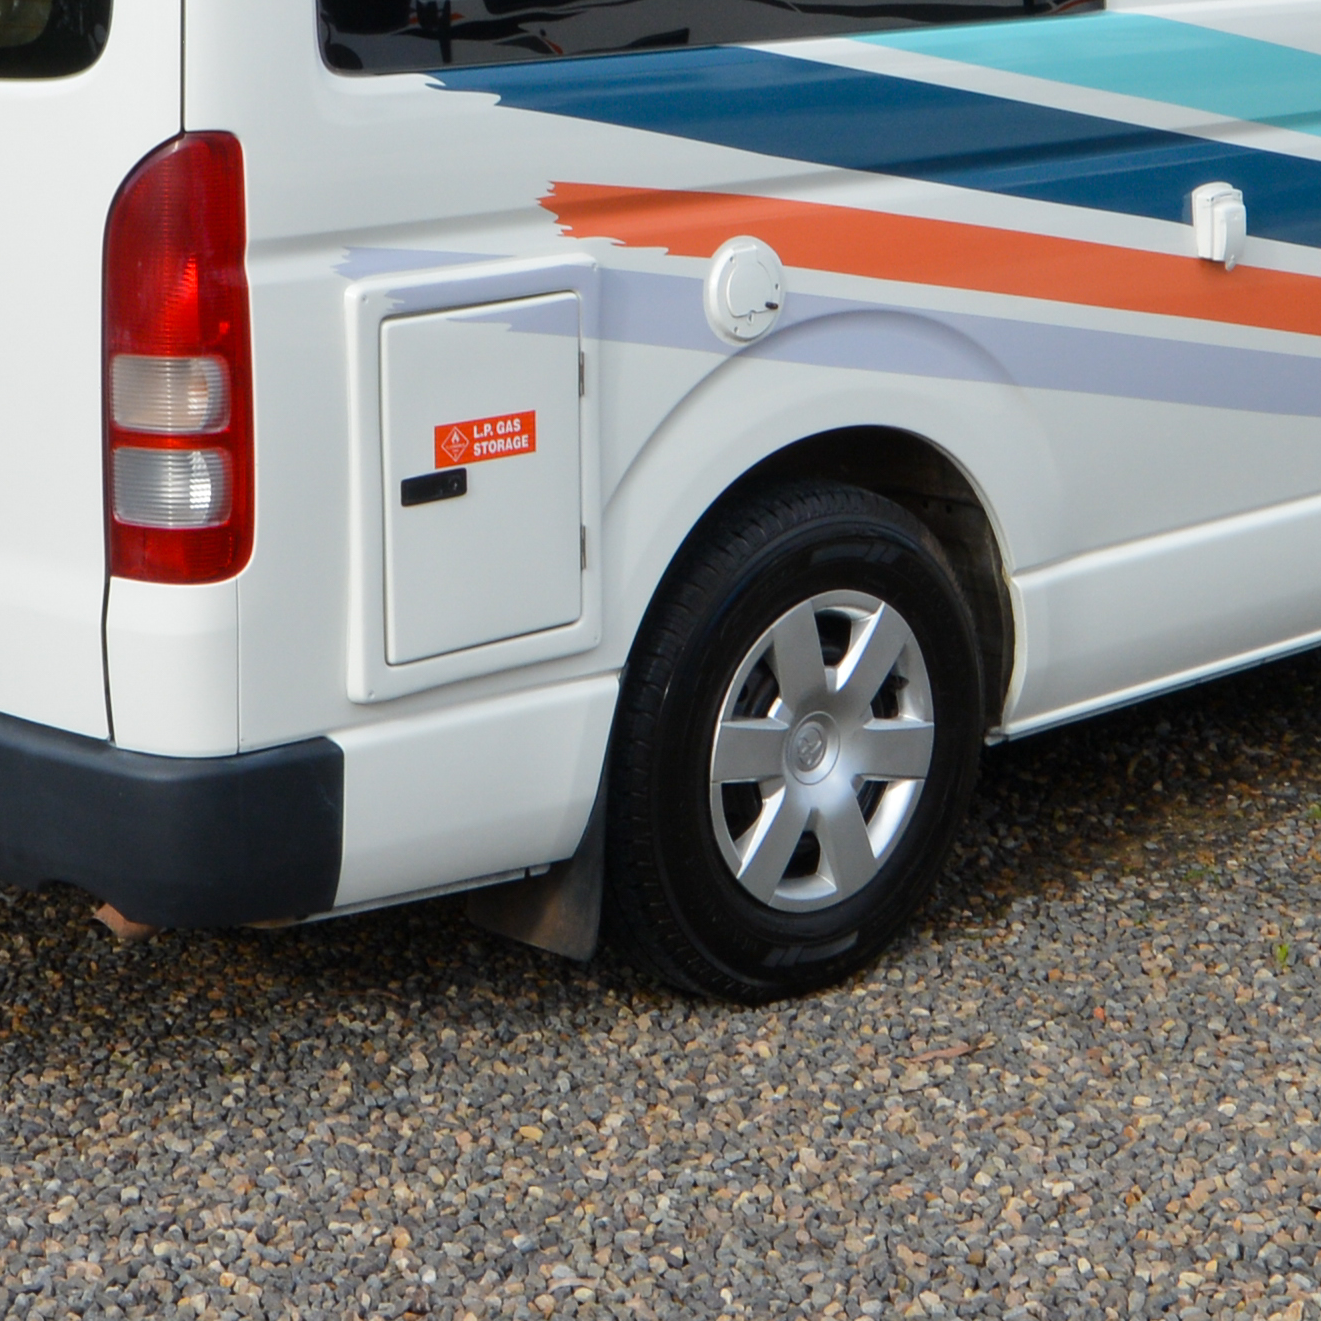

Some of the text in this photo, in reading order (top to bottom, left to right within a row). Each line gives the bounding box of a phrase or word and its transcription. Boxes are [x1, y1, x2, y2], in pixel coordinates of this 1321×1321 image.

[473, 418, 521, 438] L.P. GAS
[473, 435, 529, 457] STORAGE
